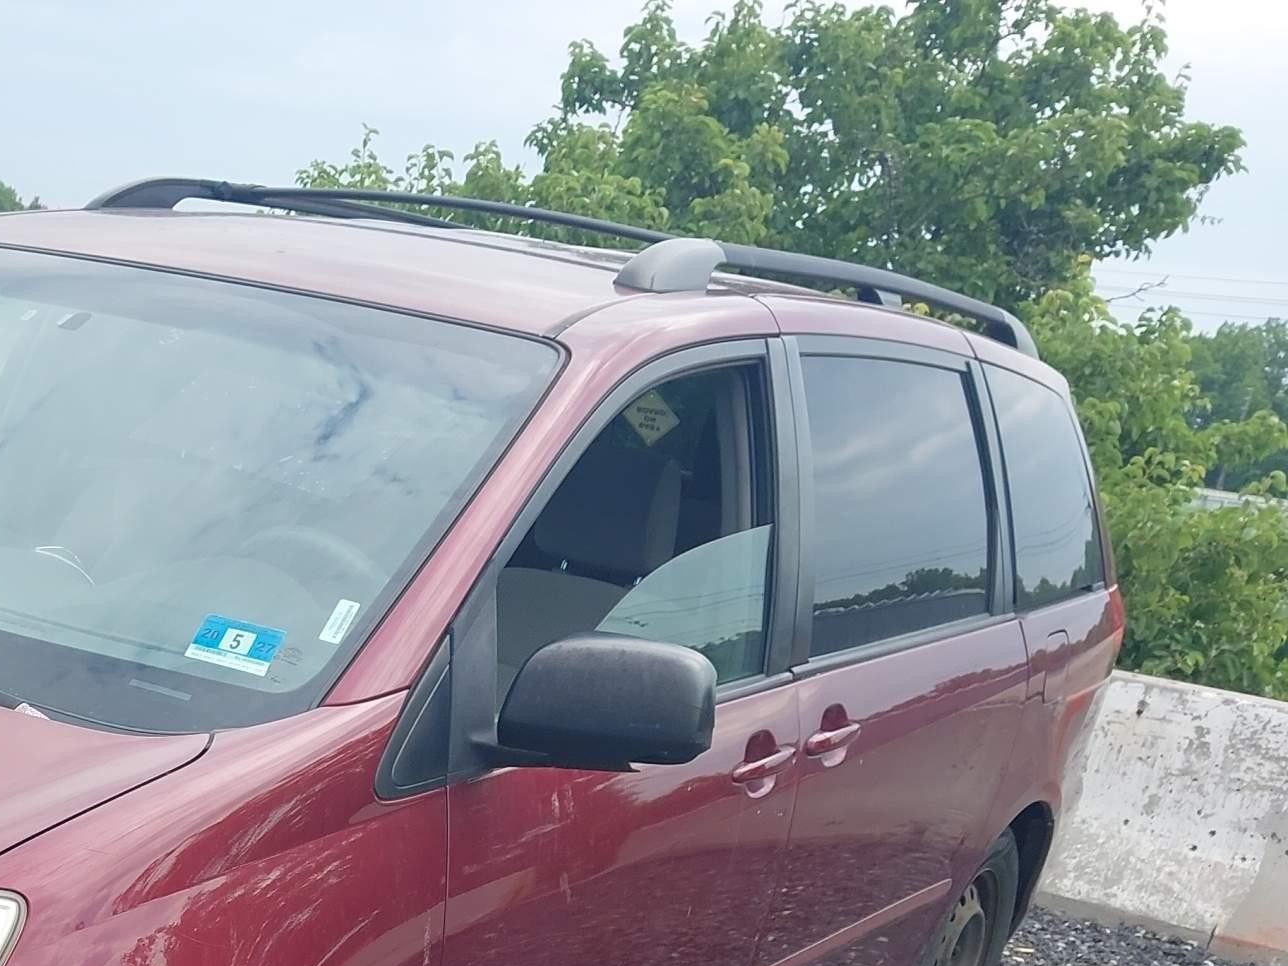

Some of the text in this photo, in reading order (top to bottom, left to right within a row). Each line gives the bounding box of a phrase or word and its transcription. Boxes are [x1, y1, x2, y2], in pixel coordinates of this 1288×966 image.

[201, 628, 277, 655] 20 5 27
